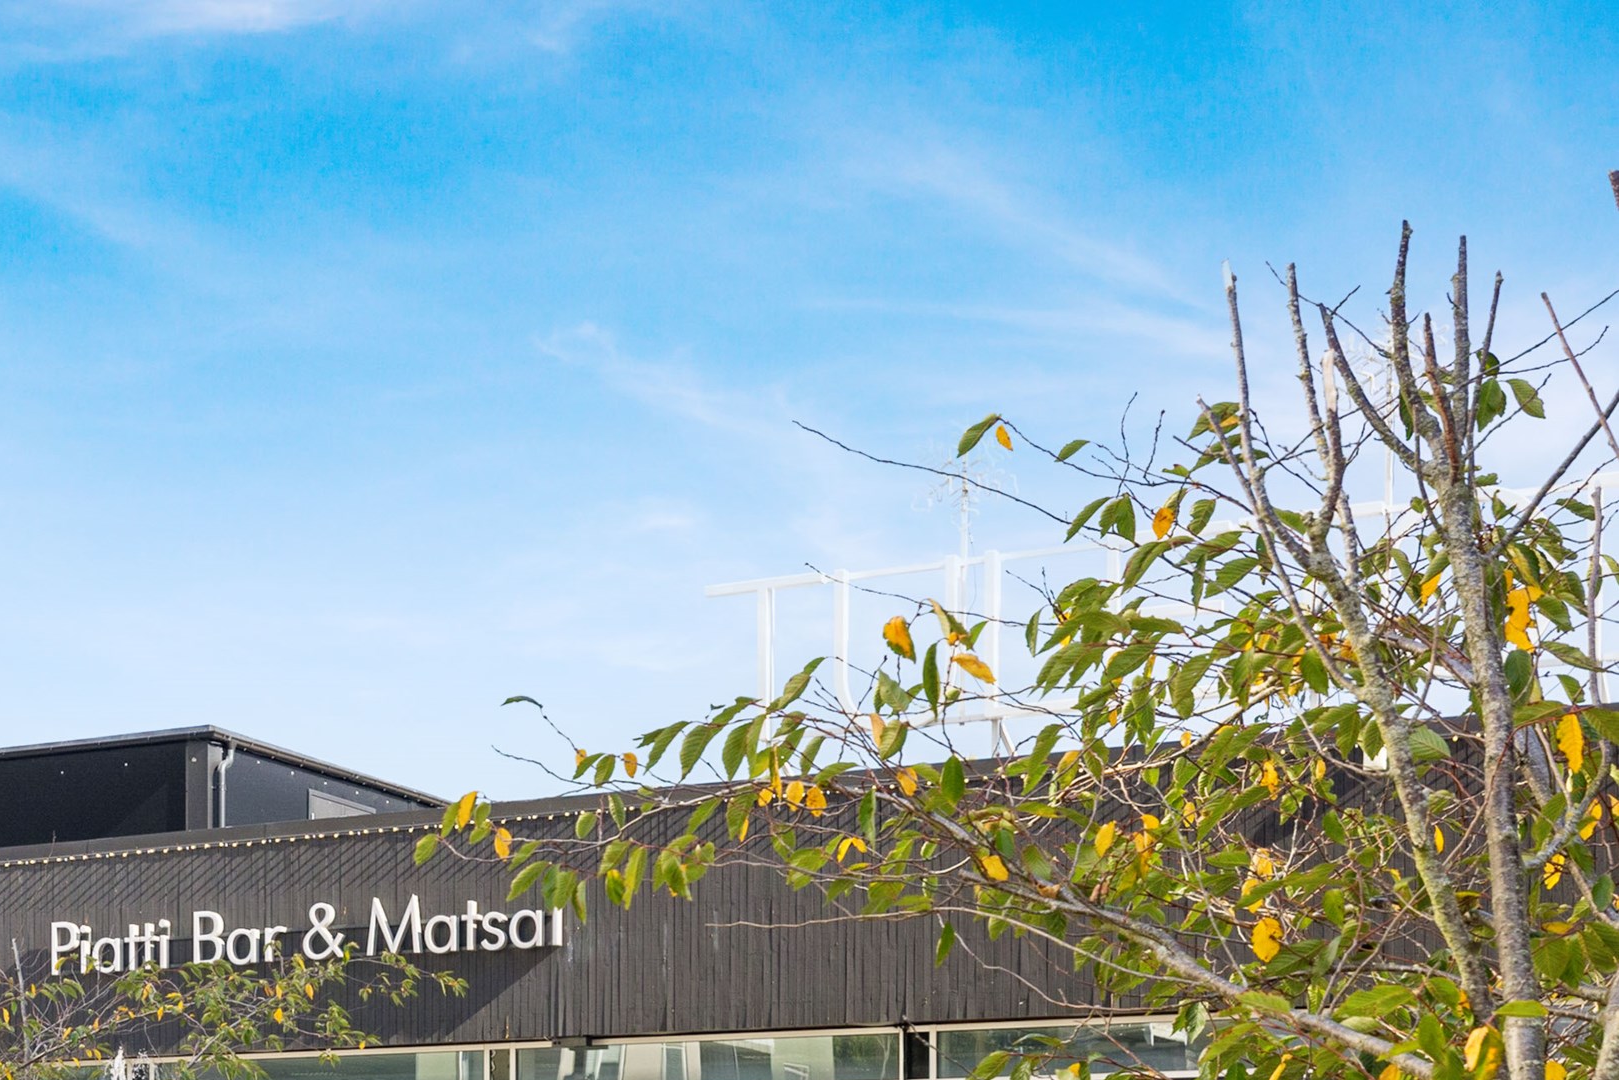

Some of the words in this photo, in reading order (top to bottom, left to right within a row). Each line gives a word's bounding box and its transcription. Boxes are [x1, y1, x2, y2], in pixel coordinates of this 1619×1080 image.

[50, 918, 171, 976] Piatti
[192, 910, 287, 966] Bar
[302, 902, 346, 961] &
[366, 893, 564, 958] Matsal
